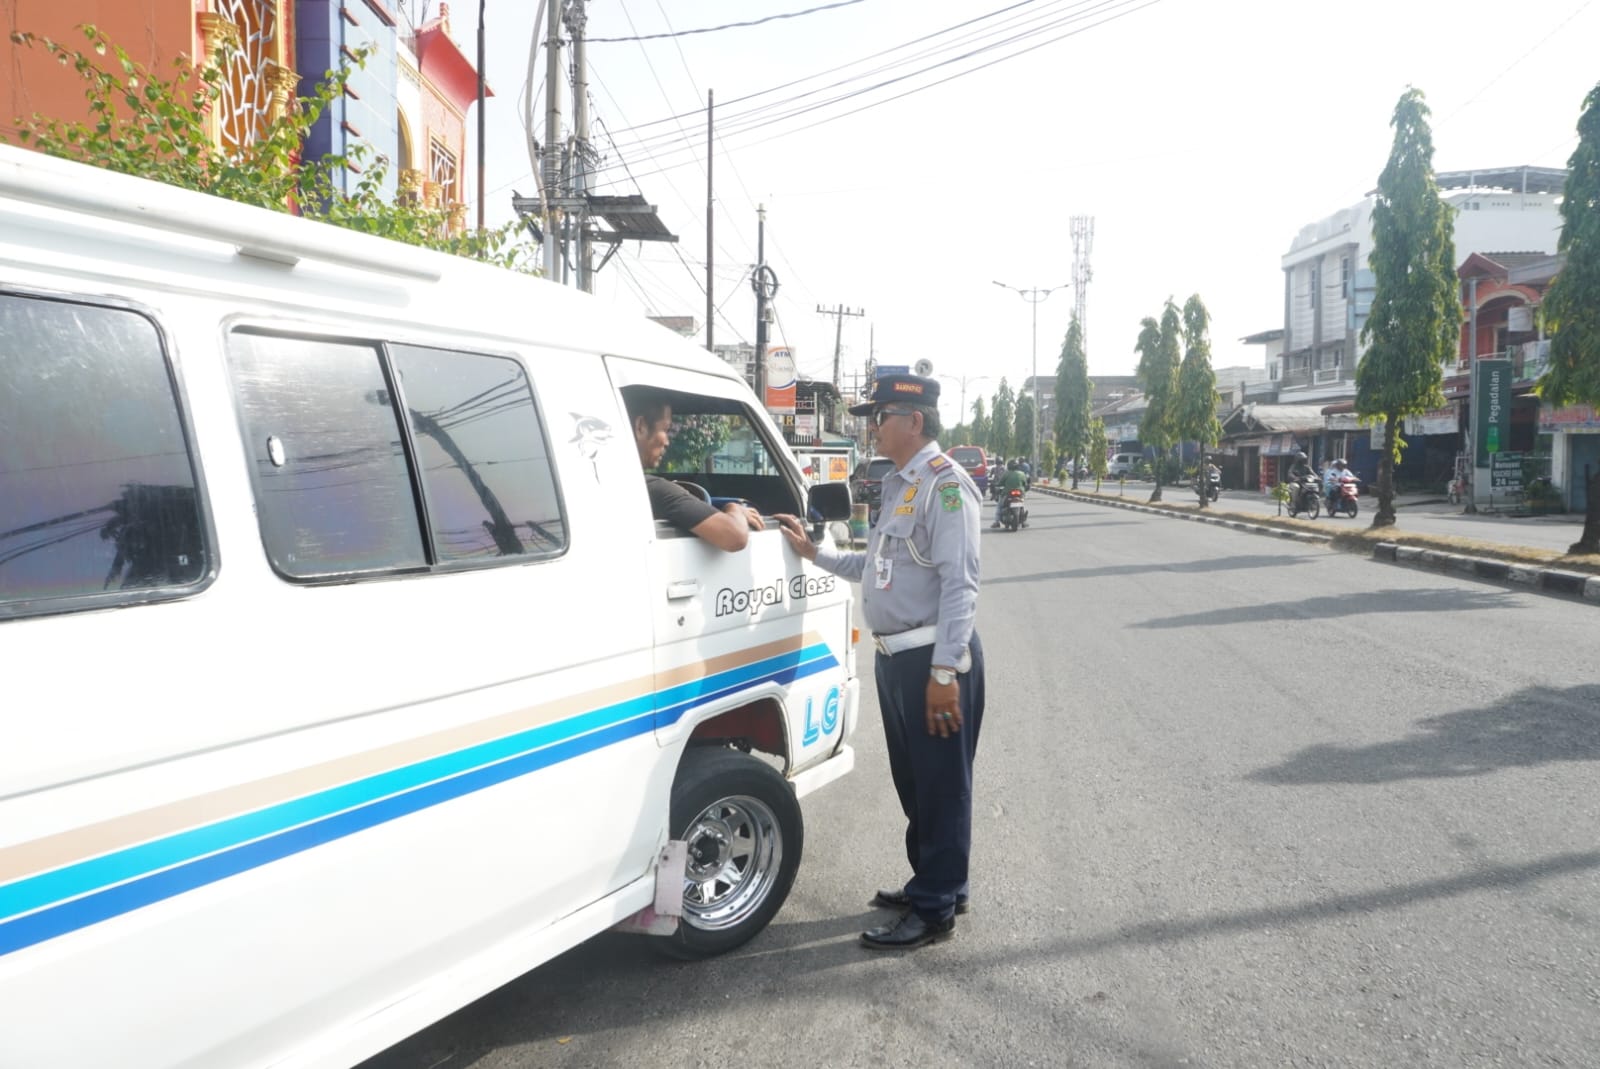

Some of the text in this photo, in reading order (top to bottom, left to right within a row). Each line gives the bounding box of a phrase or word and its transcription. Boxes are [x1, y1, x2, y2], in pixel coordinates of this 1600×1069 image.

[1488, 370, 1501, 423] Pegadaian
[715, 574, 835, 617] Royal Class
[802, 686, 840, 747] LG
